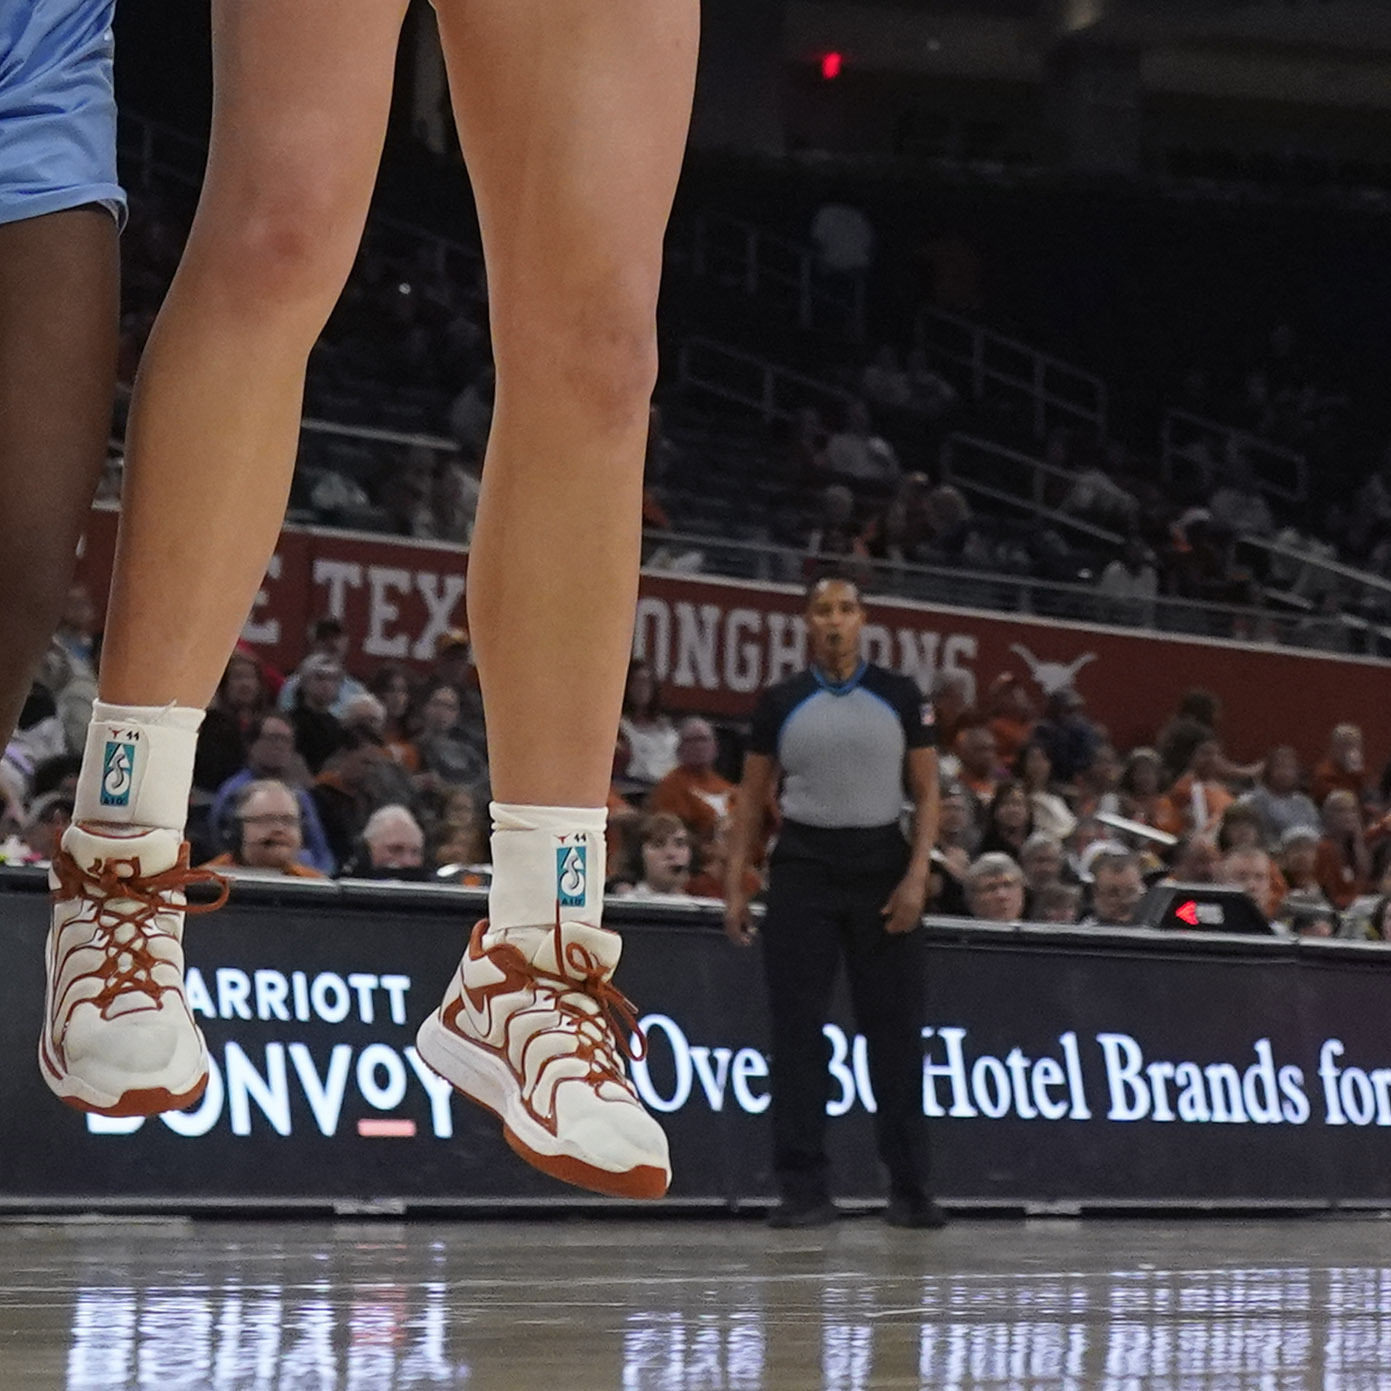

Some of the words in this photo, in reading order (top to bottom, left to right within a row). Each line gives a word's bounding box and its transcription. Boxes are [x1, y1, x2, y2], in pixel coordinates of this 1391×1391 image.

[312, 559, 467, 660] TEX
[185, 966, 411, 1026] ARRIOTT
[86, 1040, 455, 1137] ONVOY
[629, 1014, 773, 1114] Ove
[921, 1026, 1092, 1120] Hotel
[1095, 1031, 1310, 1126] Brands
